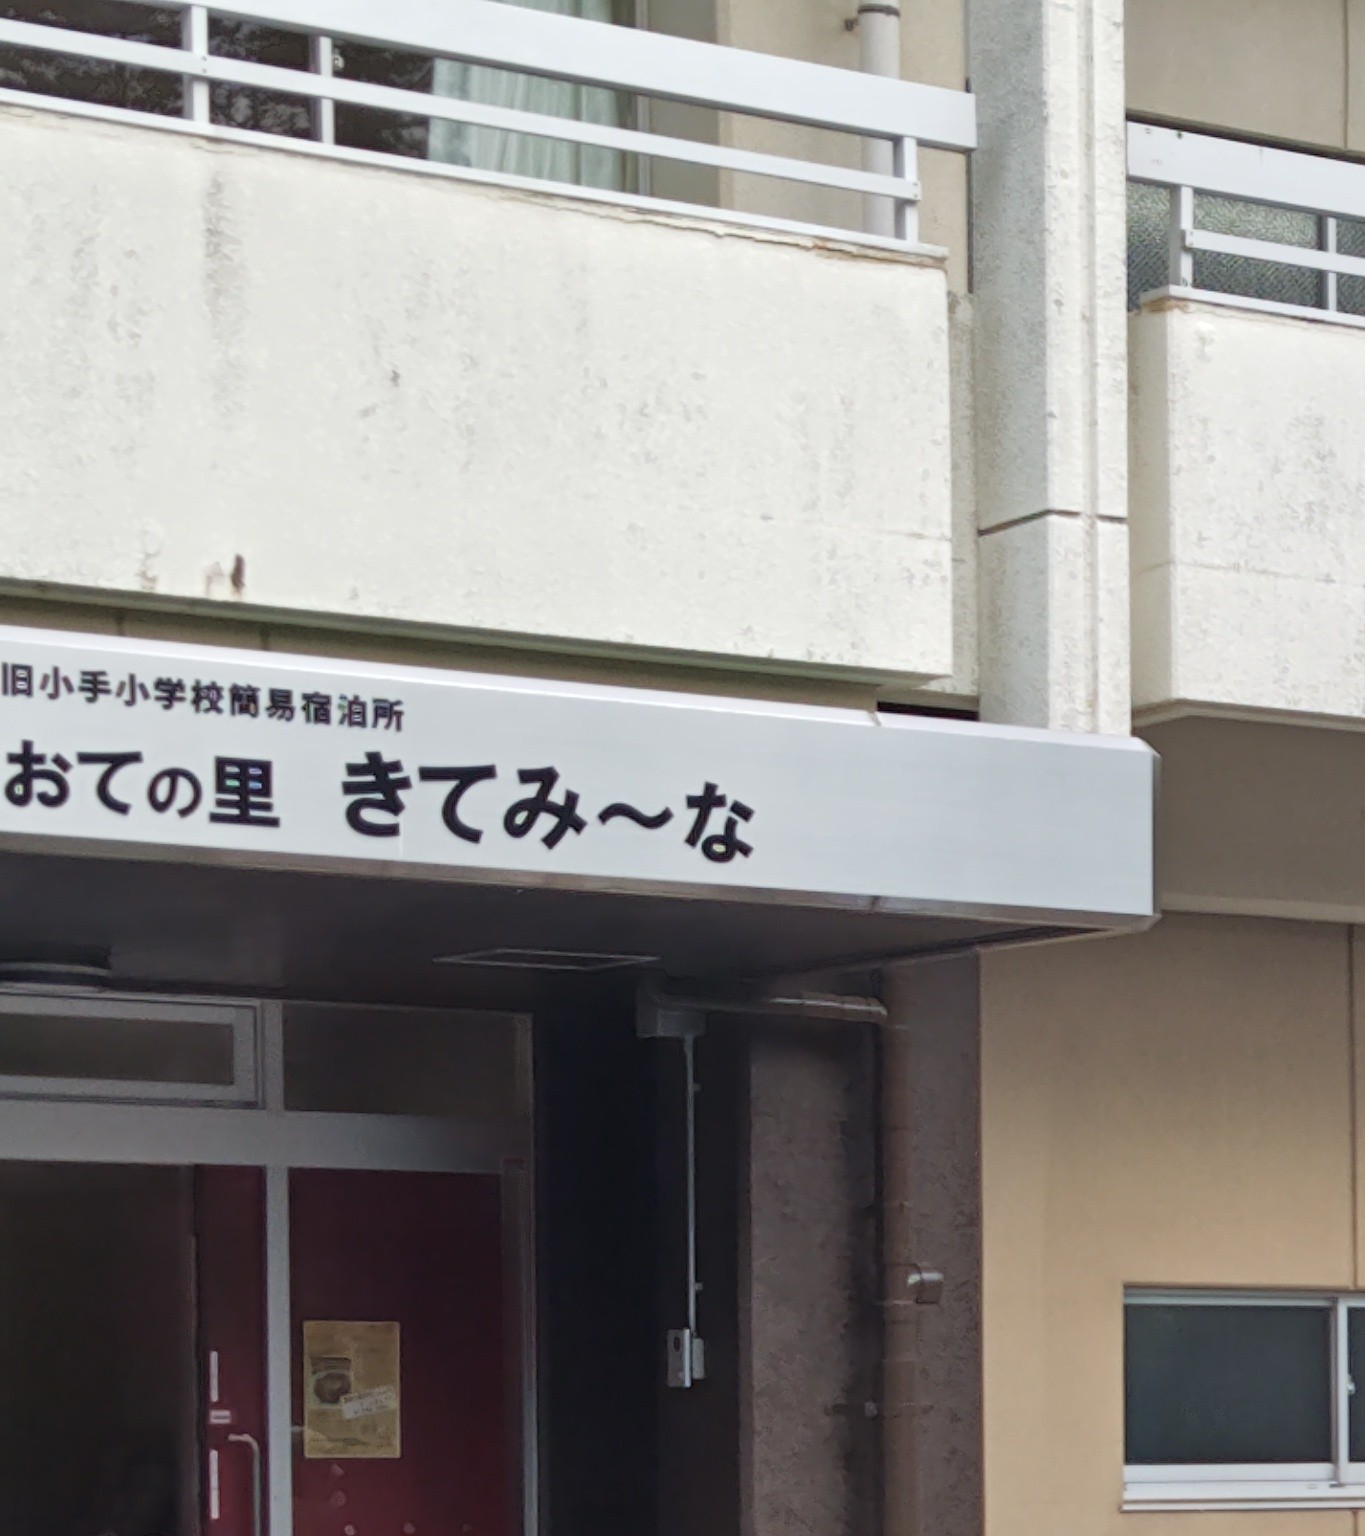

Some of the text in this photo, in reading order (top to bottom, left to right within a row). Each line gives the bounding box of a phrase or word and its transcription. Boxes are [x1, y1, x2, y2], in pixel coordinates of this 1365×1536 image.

[2, 662, 404, 732] 旧小手小学校簡易宿泊所
[4, 738, 281, 828] おての里
